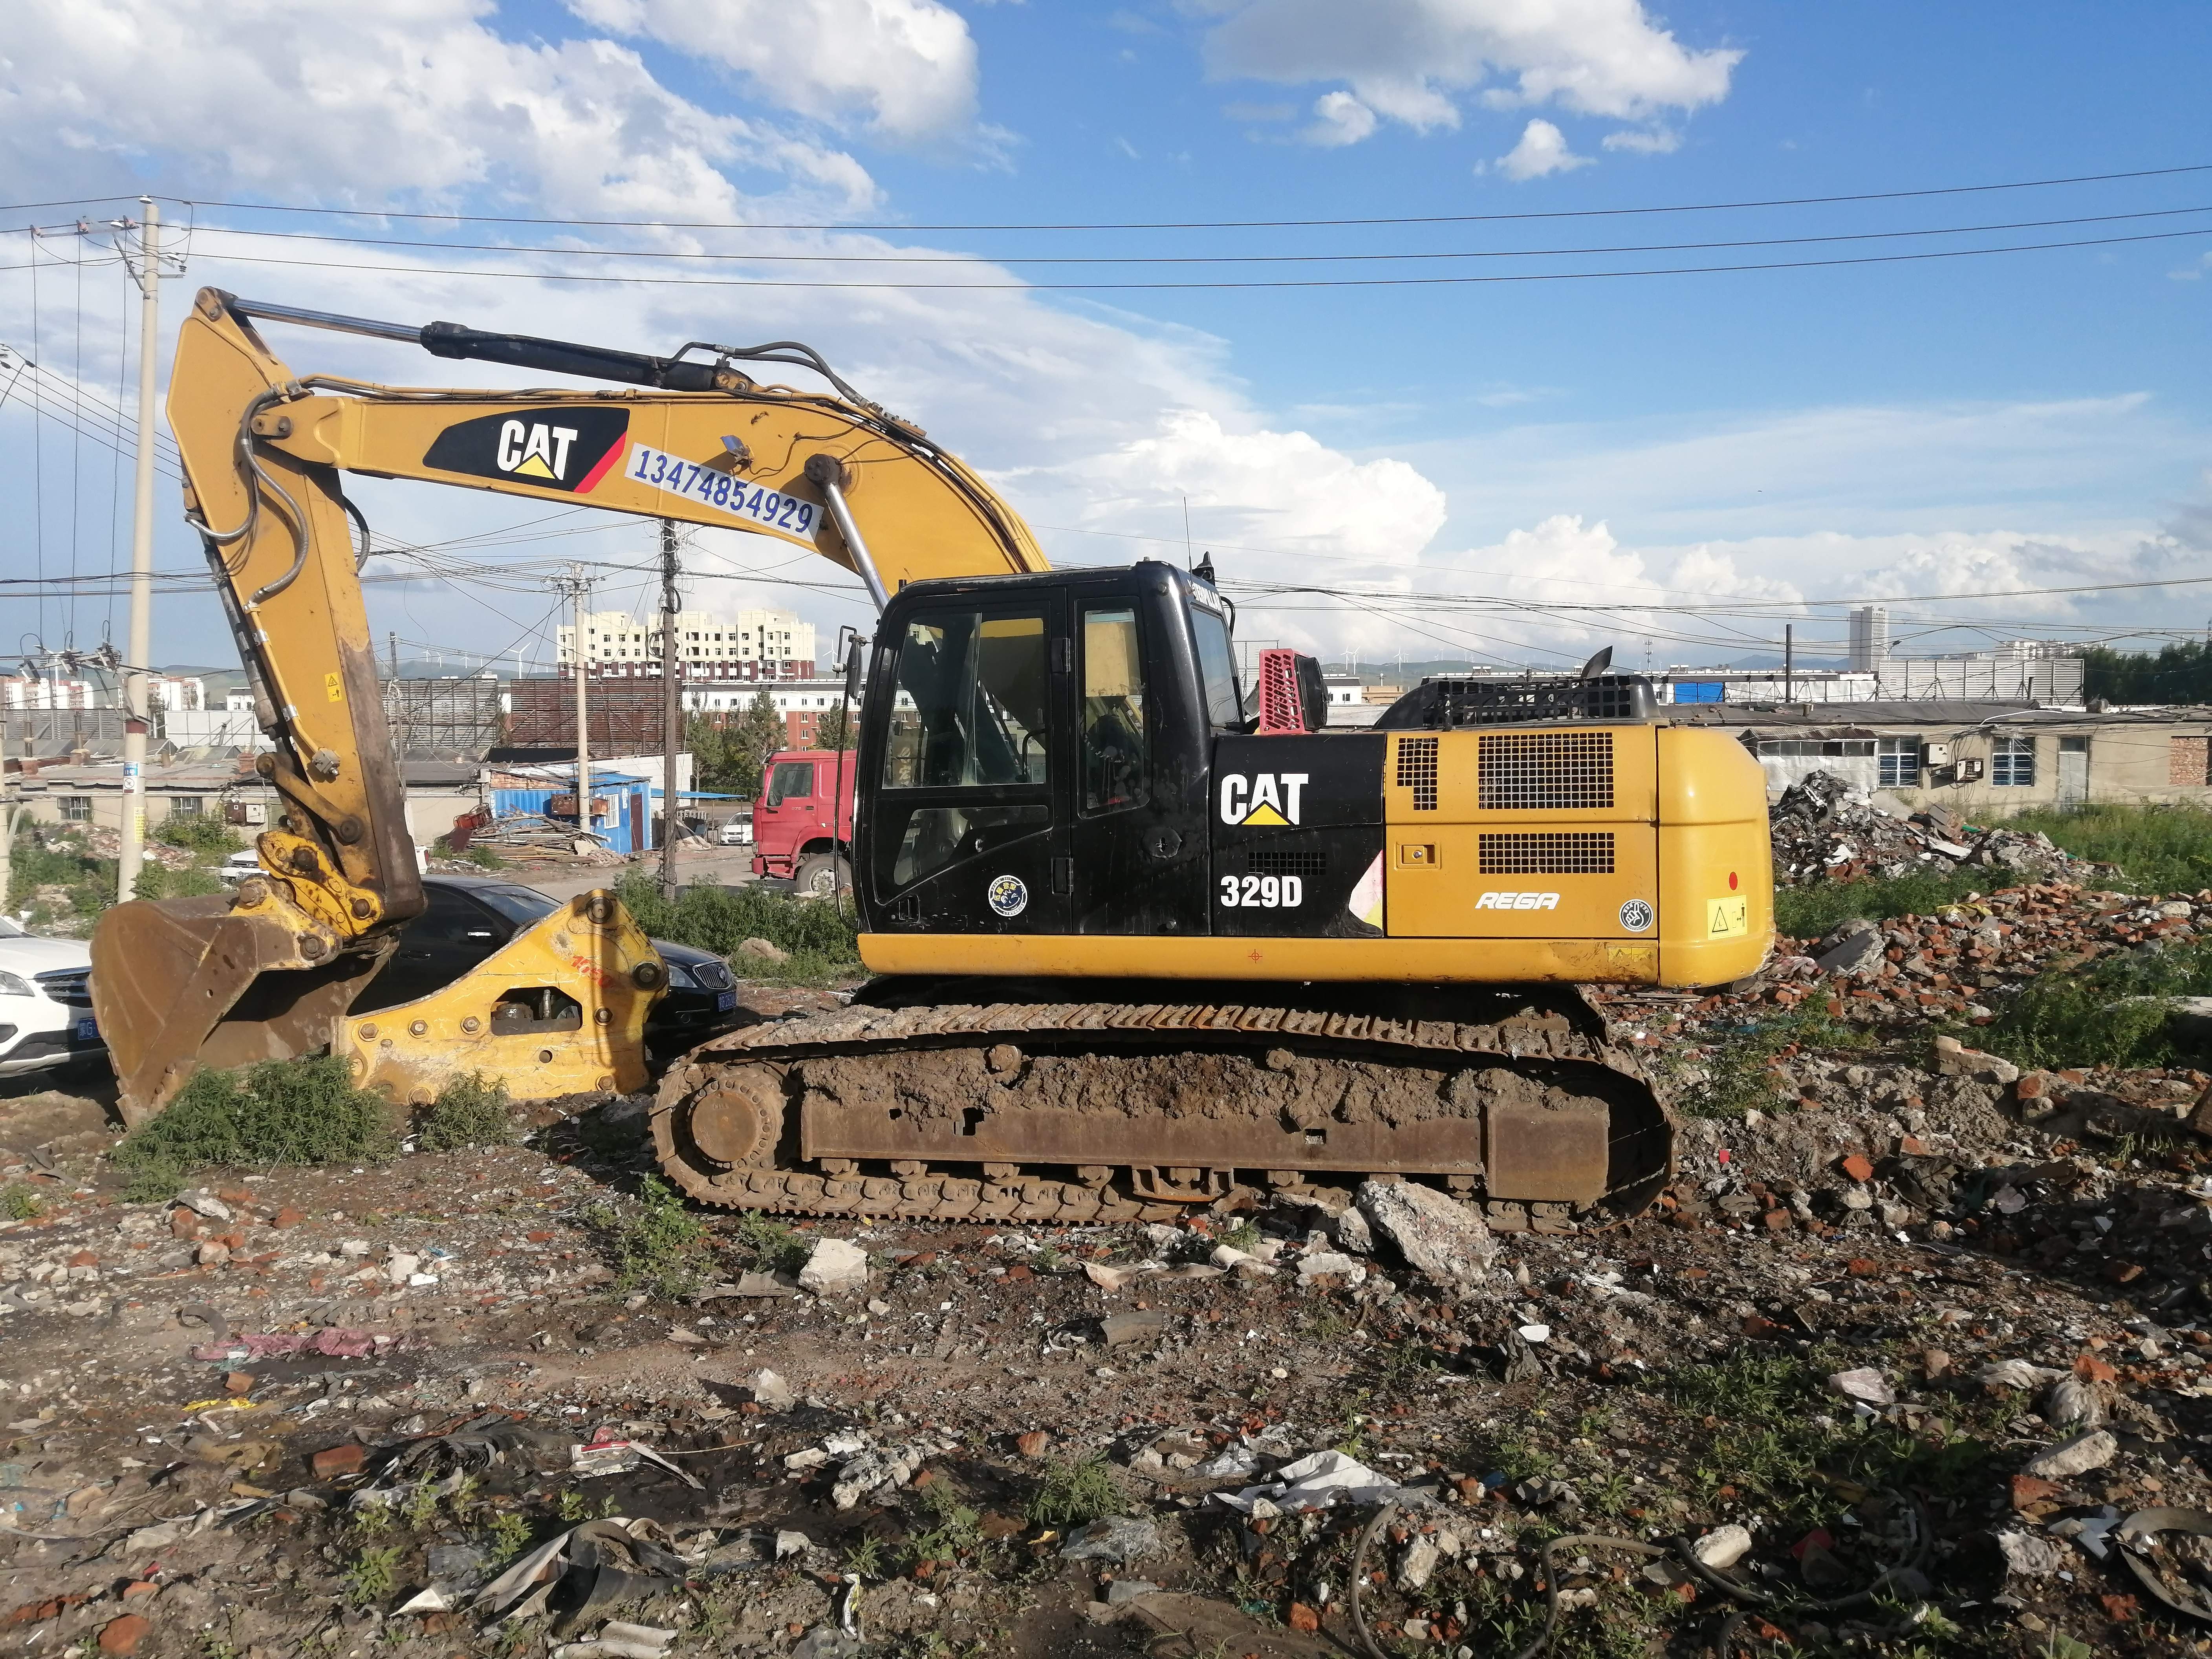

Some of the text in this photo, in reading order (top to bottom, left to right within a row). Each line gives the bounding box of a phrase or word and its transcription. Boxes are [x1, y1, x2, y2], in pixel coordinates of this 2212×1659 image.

[497, 420, 578, 480] CAT
[634, 450, 813, 533] 13474854929
[1221, 773, 1309, 825] CAT
[1221, 875, 1302, 908] 329D
[1474, 892, 1560, 910] REGA
